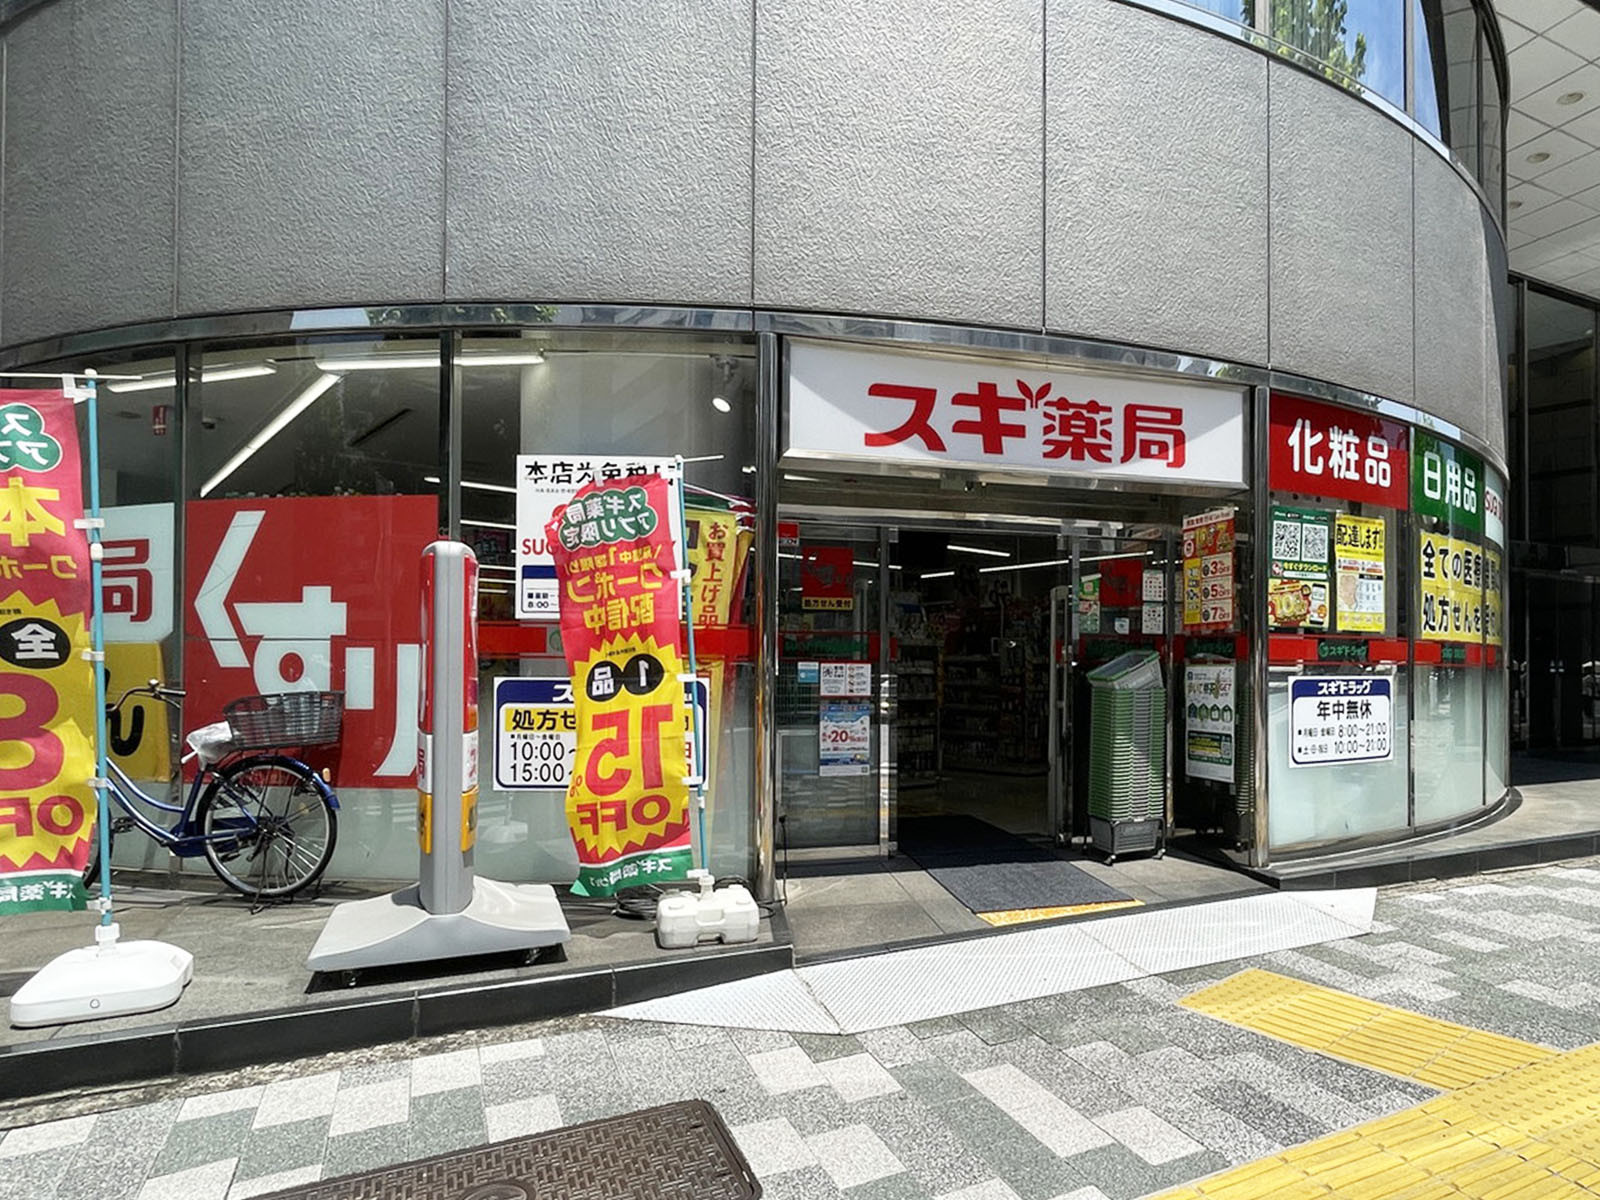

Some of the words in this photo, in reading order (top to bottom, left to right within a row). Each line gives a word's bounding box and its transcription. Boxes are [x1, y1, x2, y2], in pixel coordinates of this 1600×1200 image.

[864, 380, 1186, 468] スギ薬局
[1288, 418, 1390, 488] 化粧品
[1424, 451, 1477, 514] 日用品
[699, 521, 729, 625] お買上げ品
[1316, 700, 1373, 721] 年中無休
[1318, 680, 1373, 695] スギドラッグ
